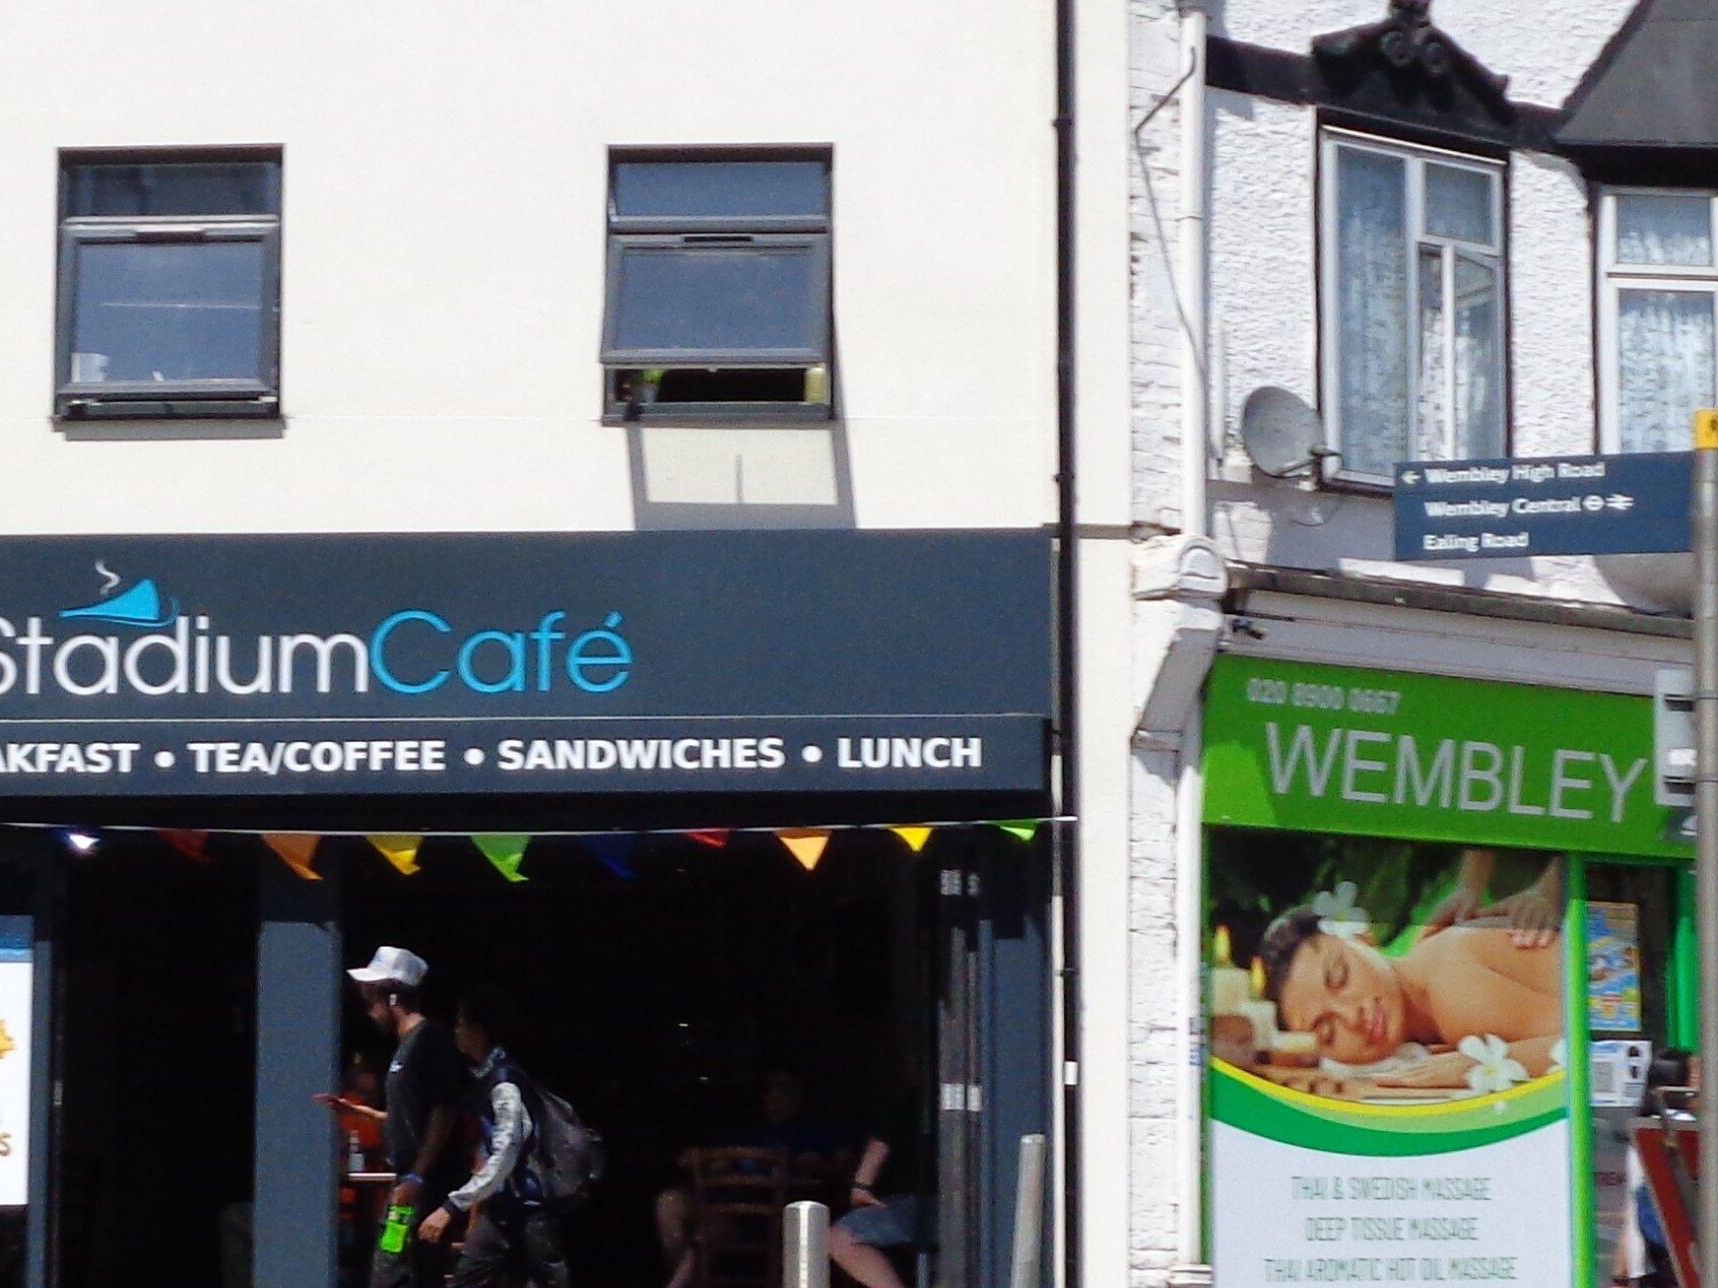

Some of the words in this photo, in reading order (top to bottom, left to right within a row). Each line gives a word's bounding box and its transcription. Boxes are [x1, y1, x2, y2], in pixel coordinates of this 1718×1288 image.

[1424, 466, 1510, 484] Wembley
[1512, 464, 1555, 482] High
[1557, 462, 1605, 478] Road
[1424, 500, 1510, 518] Wembley
[1512, 497, 1581, 513] Central
[1423, 534, 1480, 552] Ealing
[1482, 532, 1529, 548] Road
[187, 738, 446, 774] TEA/COFFEE
[497, 737, 784, 772] SANDWICHES
[837, 736, 983, 770] LUNCH
[1266, 722, 1646, 824] WEMBLEY
[1292, 1176, 1328, 1200] THAI
[1349, 1176, 1419, 1200] SWEDISH
[1422, 1176, 1492, 1201] MASSAGE
[1305, 1217, 1347, 1241] DEEP
[1351, 1217, 1405, 1241] TISSUE
[1409, 1217, 1479, 1241] MASSAGE
[1264, 1258, 1301, 1282] THAI
[1305, 1257, 1381, 1282] AROMATIC
[1386, 1257, 1416, 1281] HOT
[1420, 1257, 1445, 1281] OIL
[1448, 1257, 1518, 1281] MASSAGE
